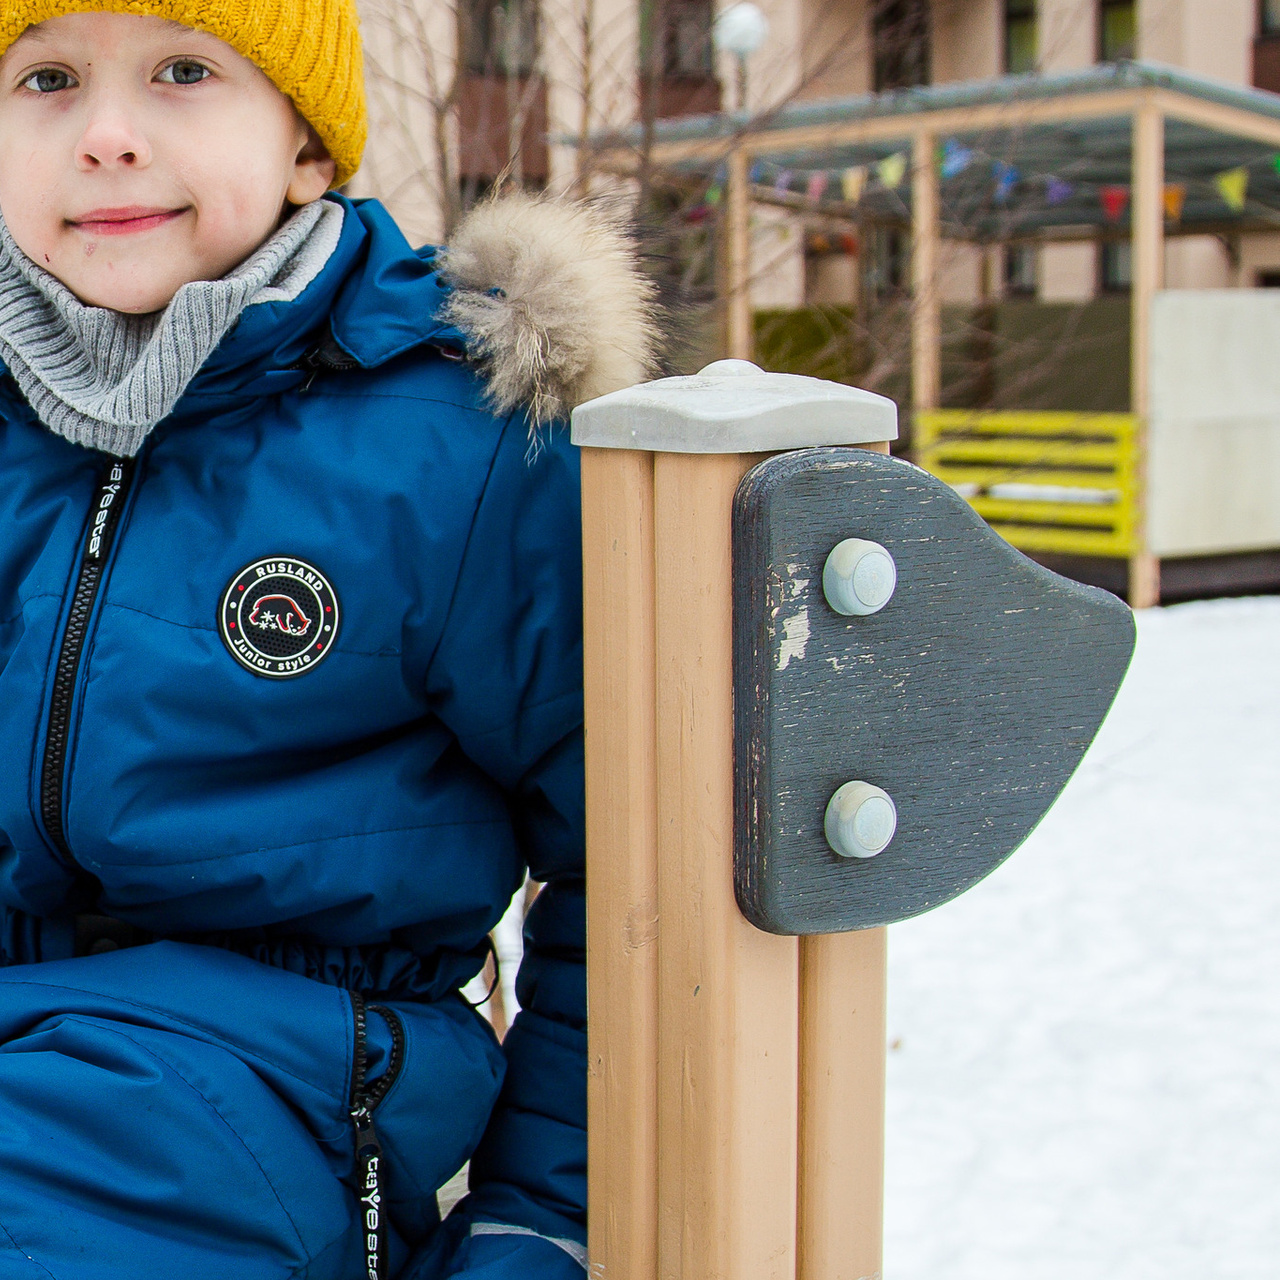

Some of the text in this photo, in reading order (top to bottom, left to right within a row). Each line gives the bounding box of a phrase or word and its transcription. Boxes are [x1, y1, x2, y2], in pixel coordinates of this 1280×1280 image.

[255, 562, 324, 591] RUSLAND
[233, 638, 311, 671] Junior style
